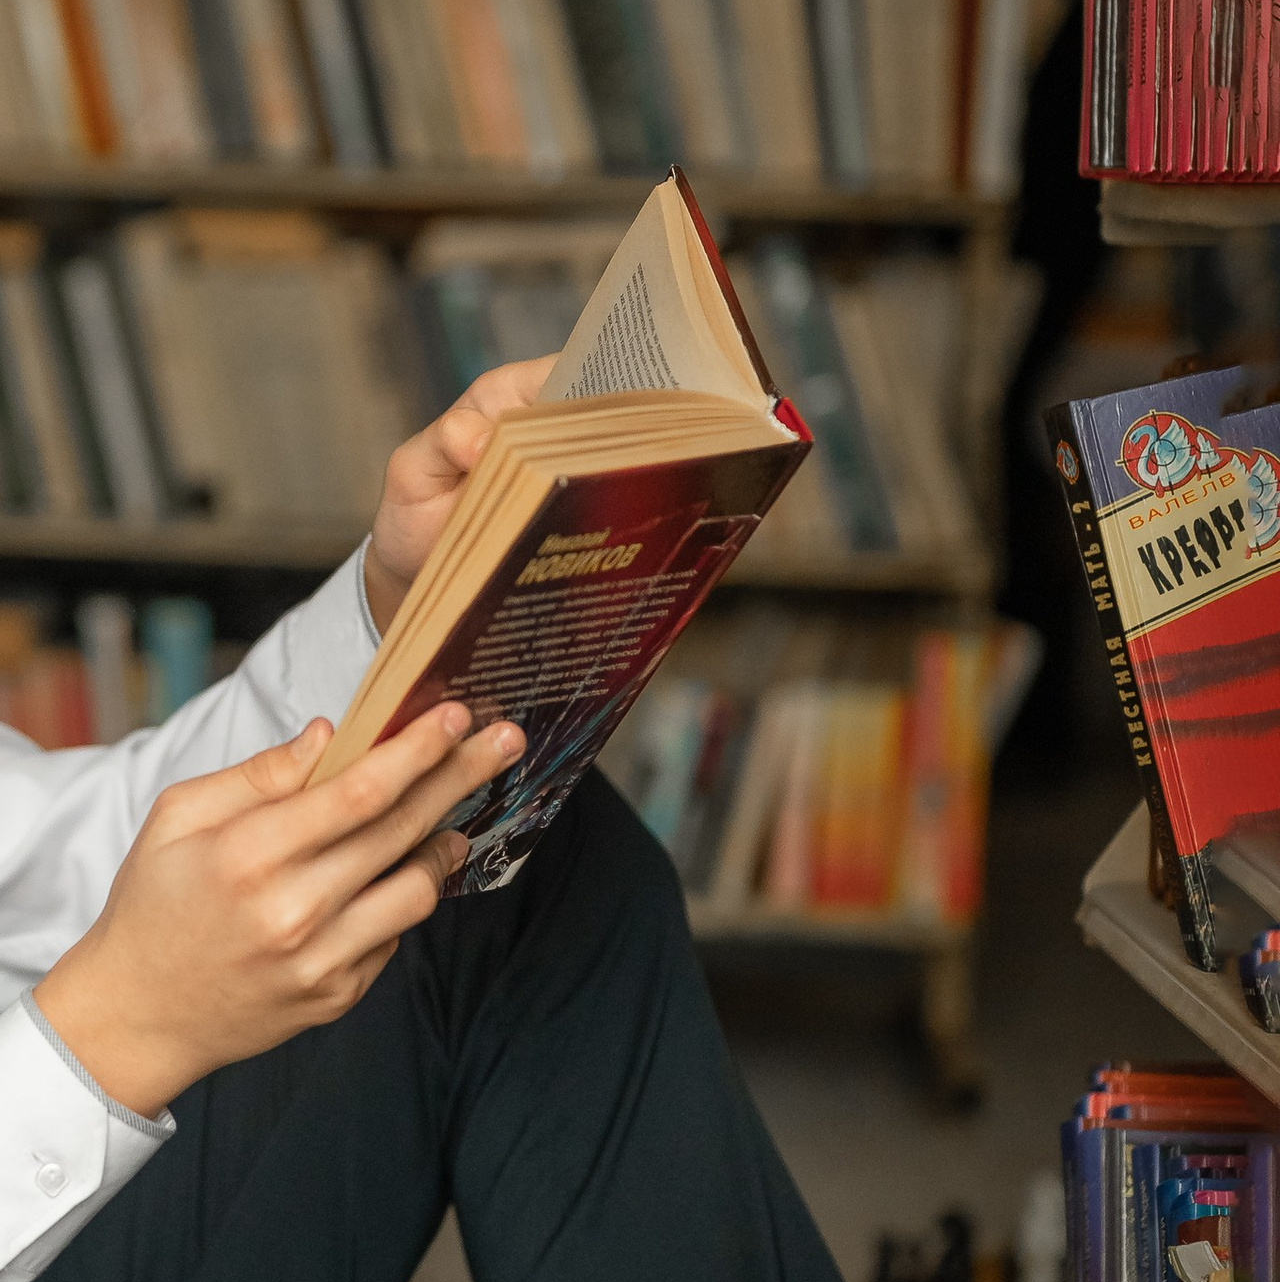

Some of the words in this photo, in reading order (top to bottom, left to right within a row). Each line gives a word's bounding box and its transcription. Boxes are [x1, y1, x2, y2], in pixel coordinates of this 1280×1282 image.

[1071, 499, 1091, 514] 2
[514, 542, 644, 588] НОВИКОВ
[1082, 541, 1115, 611] МАТЬ
[1105, 635, 1153, 767] КРЕСТНАЯ
